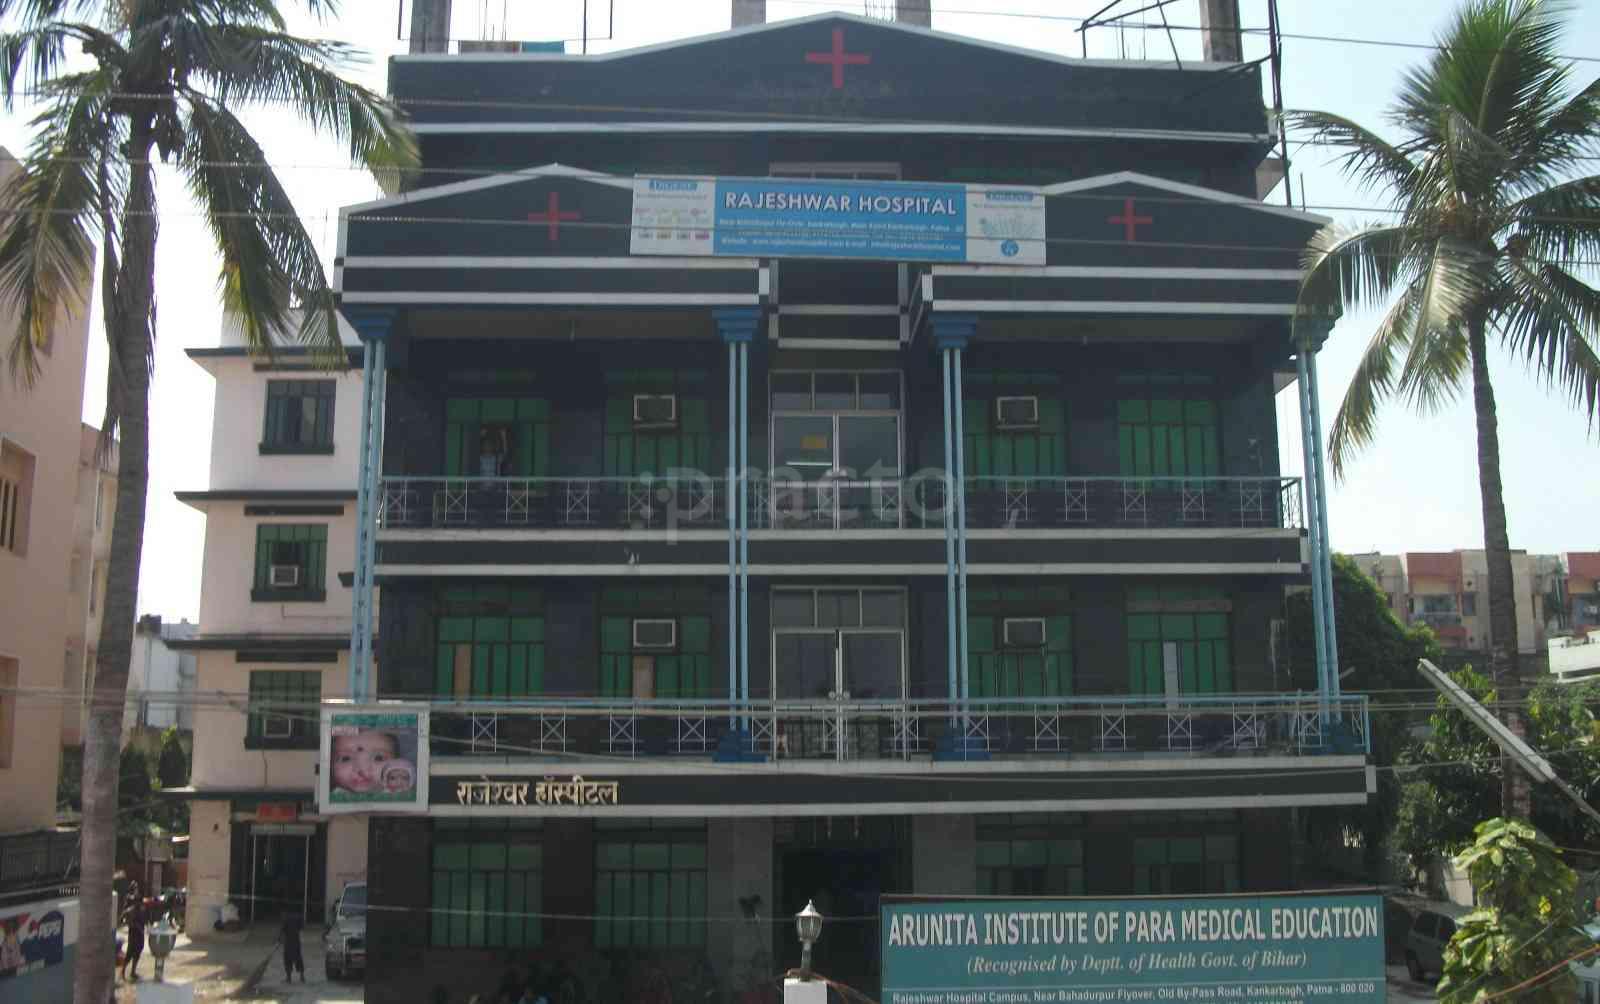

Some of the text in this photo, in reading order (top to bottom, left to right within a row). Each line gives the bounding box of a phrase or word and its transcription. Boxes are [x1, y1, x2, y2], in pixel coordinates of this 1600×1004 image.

[725, 191, 956, 215] RAJESHWAR HOSPITAL
[888, 906, 1378, 946] ARUNITA INSTITUTE OF PARA MEDICAL EDUCATION
[967, 949, 1307, 975] (Recognised by Deptt. of Health Govt. of Bihar)
[892, 991, 942, 1004] Rajeshwar
[946, 991, 986, 1004] Hospital
[989, 991, 1031, 1004] Campus,
[1034, 990, 1055, 1002] Near
[1158, 987, 1174, 999] Old
[1307, 983, 1332, 994] Patna
